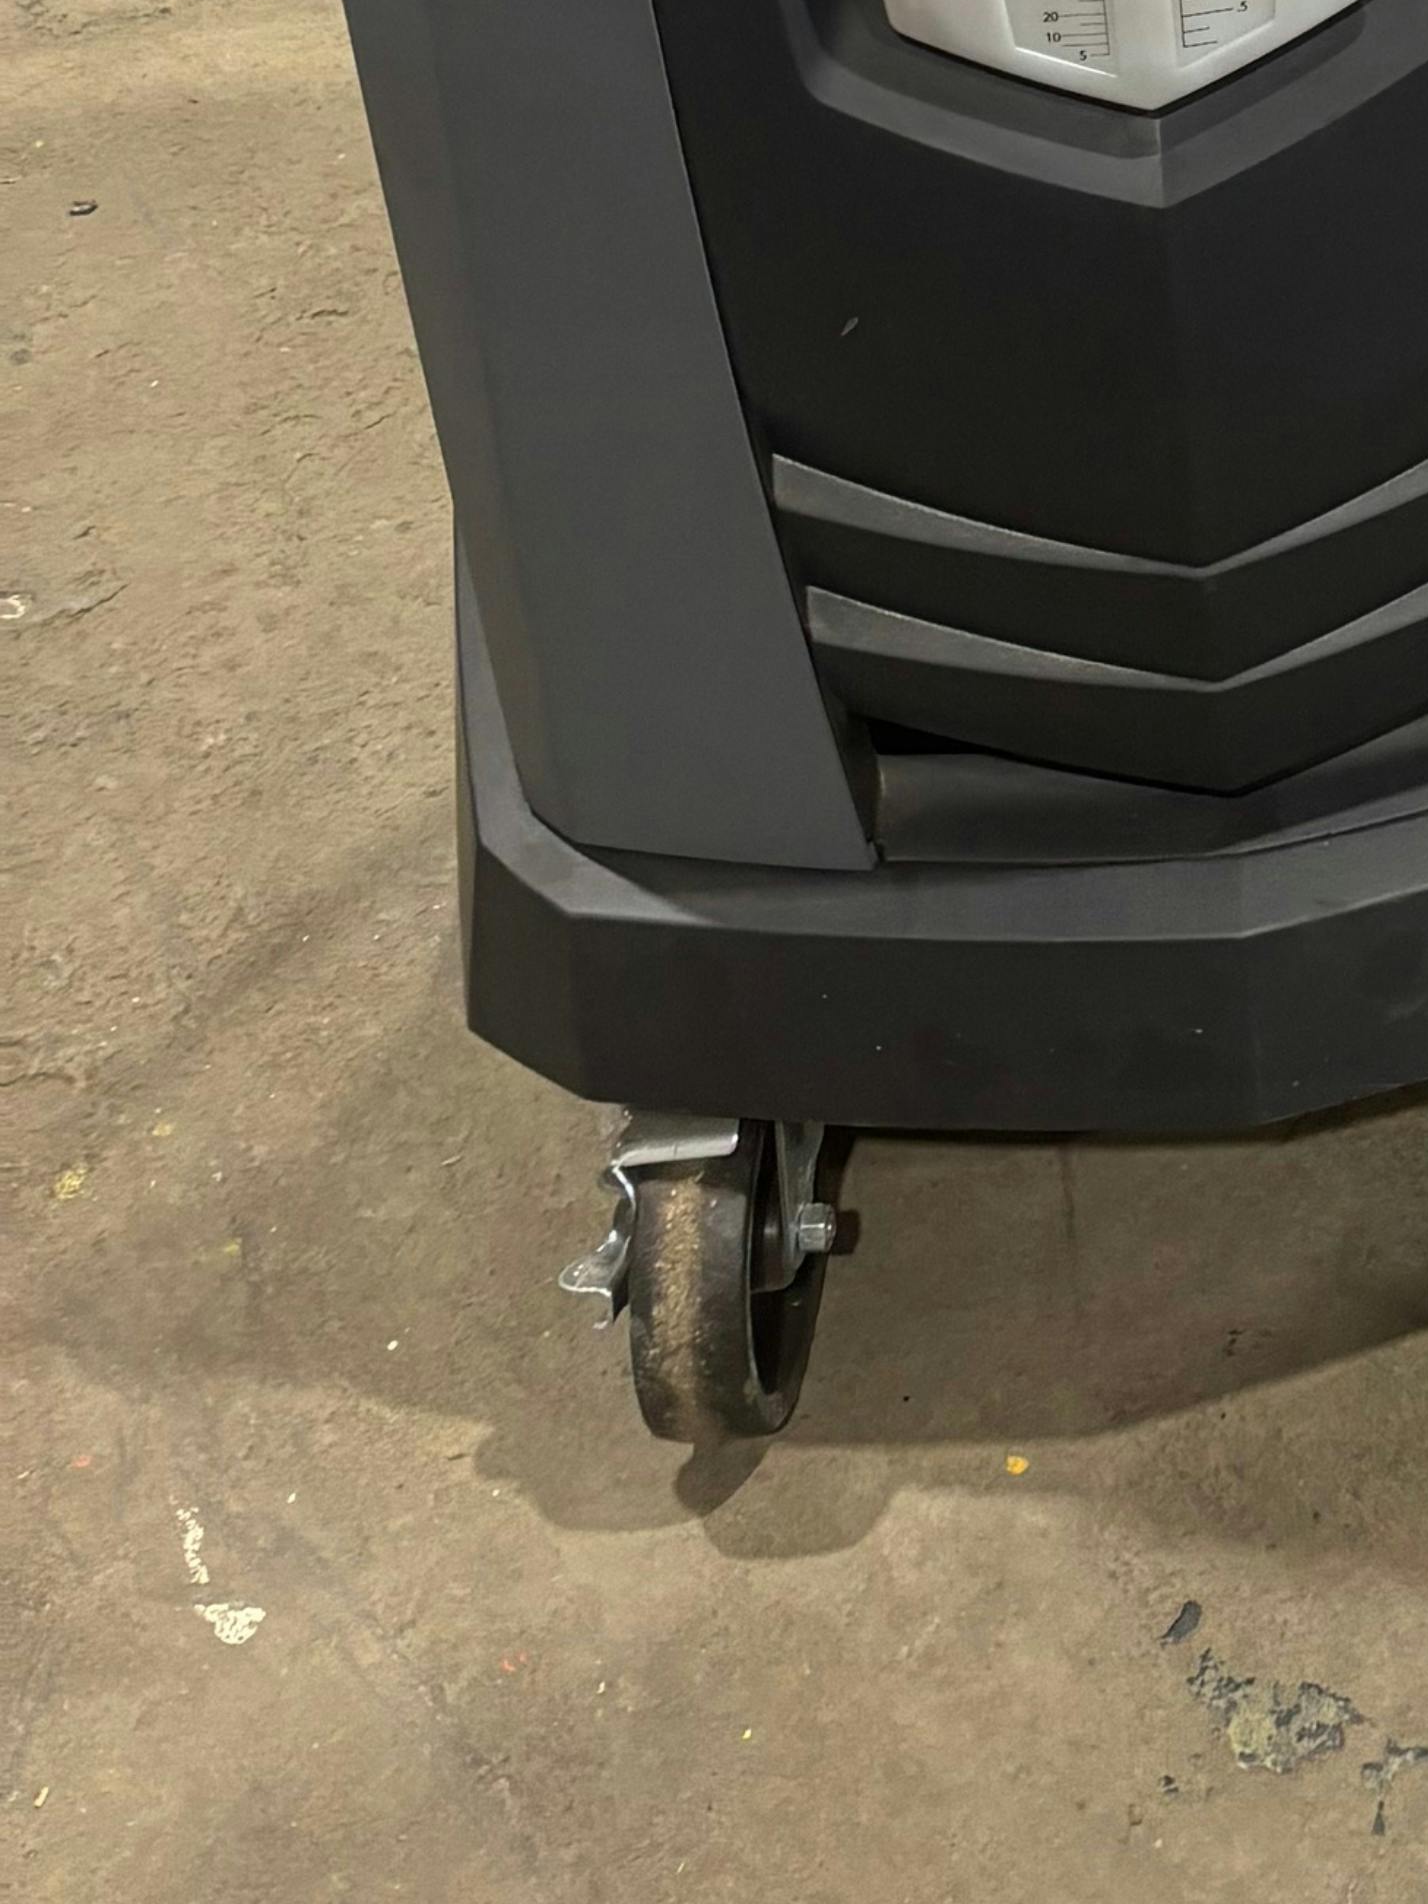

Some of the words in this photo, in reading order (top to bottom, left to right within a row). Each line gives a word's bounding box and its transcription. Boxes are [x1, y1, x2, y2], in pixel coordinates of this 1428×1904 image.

[1236, 0, 1248, 12] .5
[1043, 11, 1059, 23] 20
[1046, 32, 1062, 43] 10
[1079, 50, 1087, 62] 5
